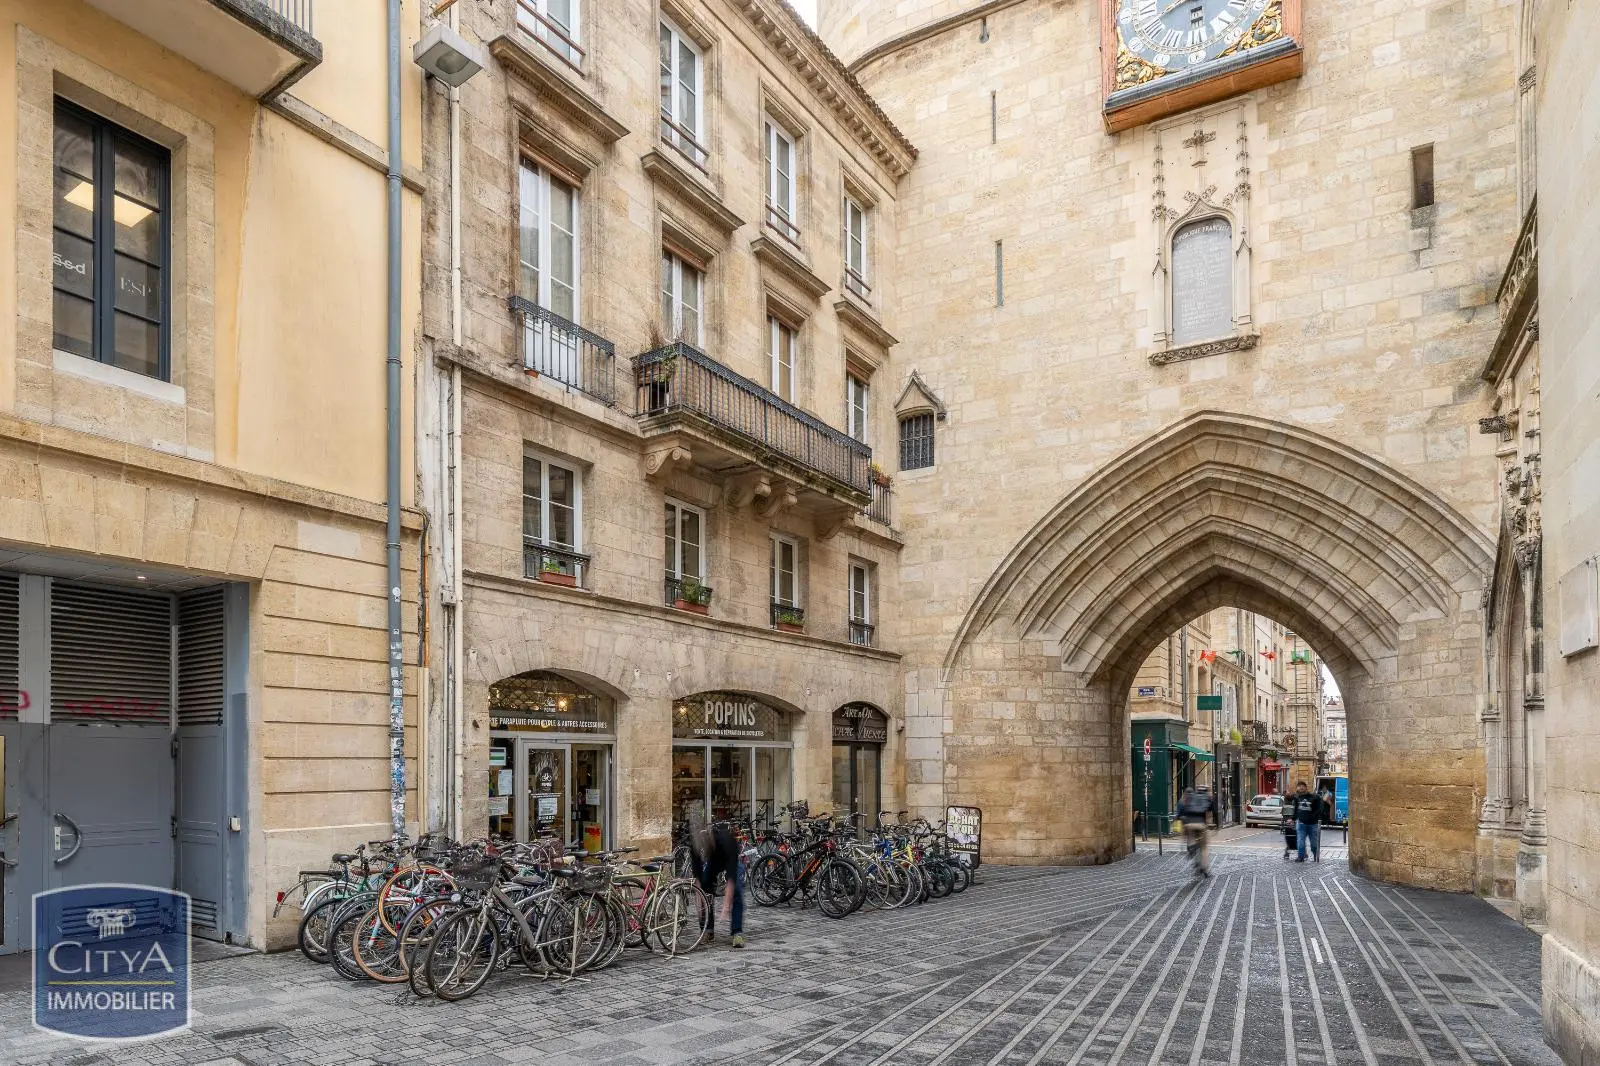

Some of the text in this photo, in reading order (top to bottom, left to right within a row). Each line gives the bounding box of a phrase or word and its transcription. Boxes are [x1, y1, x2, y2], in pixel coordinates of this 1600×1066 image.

[704, 699, 756, 726] POPINS
[499, 717, 527, 726] PARAPLUIE
[948, 815, 979, 825] ACHAT
